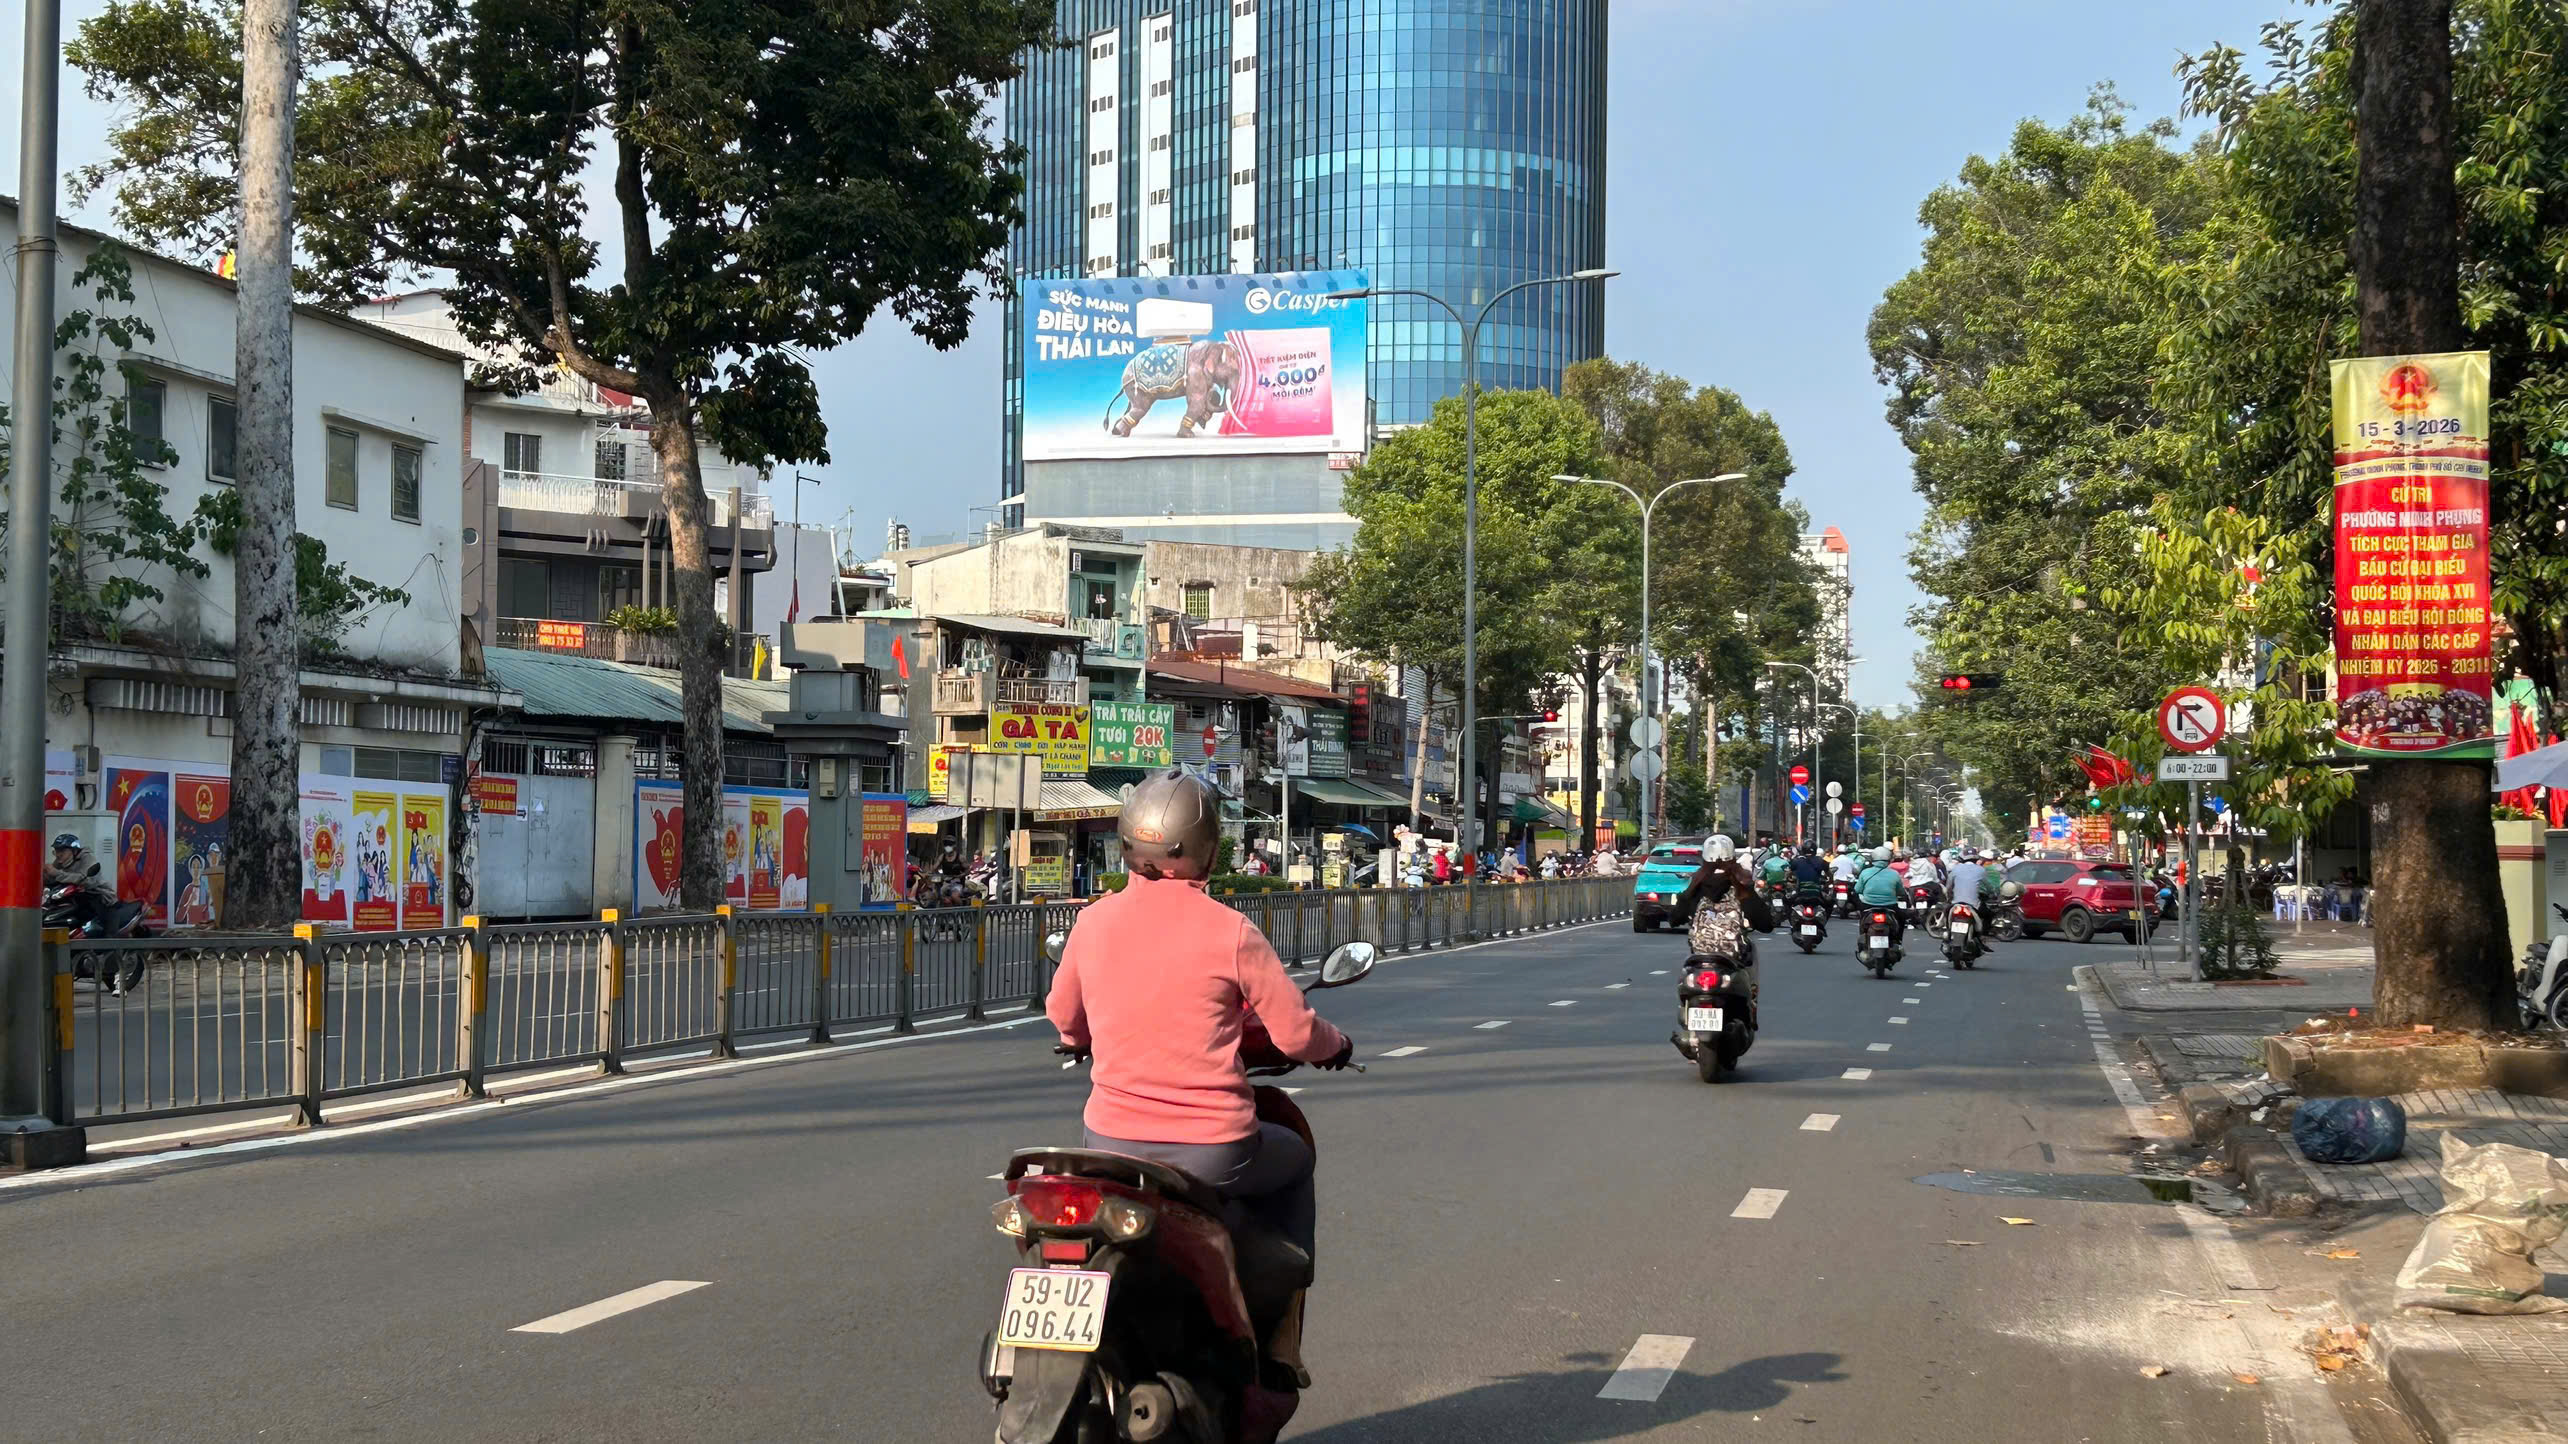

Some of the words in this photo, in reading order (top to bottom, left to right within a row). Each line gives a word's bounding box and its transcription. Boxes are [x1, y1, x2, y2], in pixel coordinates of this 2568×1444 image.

[1049, 288, 1082, 307] SỨC
[1086, 296, 1128, 313] MẠNH
[1272, 290, 1350, 315] Casper
[1038, 304, 1088, 332] ĐIỀU
[1093, 314, 1133, 335] HÒA
[1036, 332, 1091, 361] THÁI
[1096, 338, 1134, 356] LAN
[2350, 534, 2379, 552] TÍCH
[2412, 535, 2448, 552] THAM
[2452, 534, 2475, 550] GIA
[2454, 583, 2476, 599] XVI
[2342, 606, 2360, 625] VÀ
[2352, 630, 2390, 650] NHÂN
[2392, 631, 2419, 650] DÂN
[2423, 631, 2450, 650] CÁC
[2453, 627, 2480, 648] CẤP
[1095, 704, 1116, 721] TRÀ
[1120, 705, 1145, 722] TRÁI
[1149, 705, 1170, 724] CÂY
[1002, 716, 1038, 738] GÀ
[1044, 720, 1079, 740] TA
[1098, 726, 1126, 744] TƯƠI
[1134, 725, 1164, 747] 20K
[1022, 1275, 1094, 1307] 59-U2
[1006, 1309, 1094, 1342] 096.44
